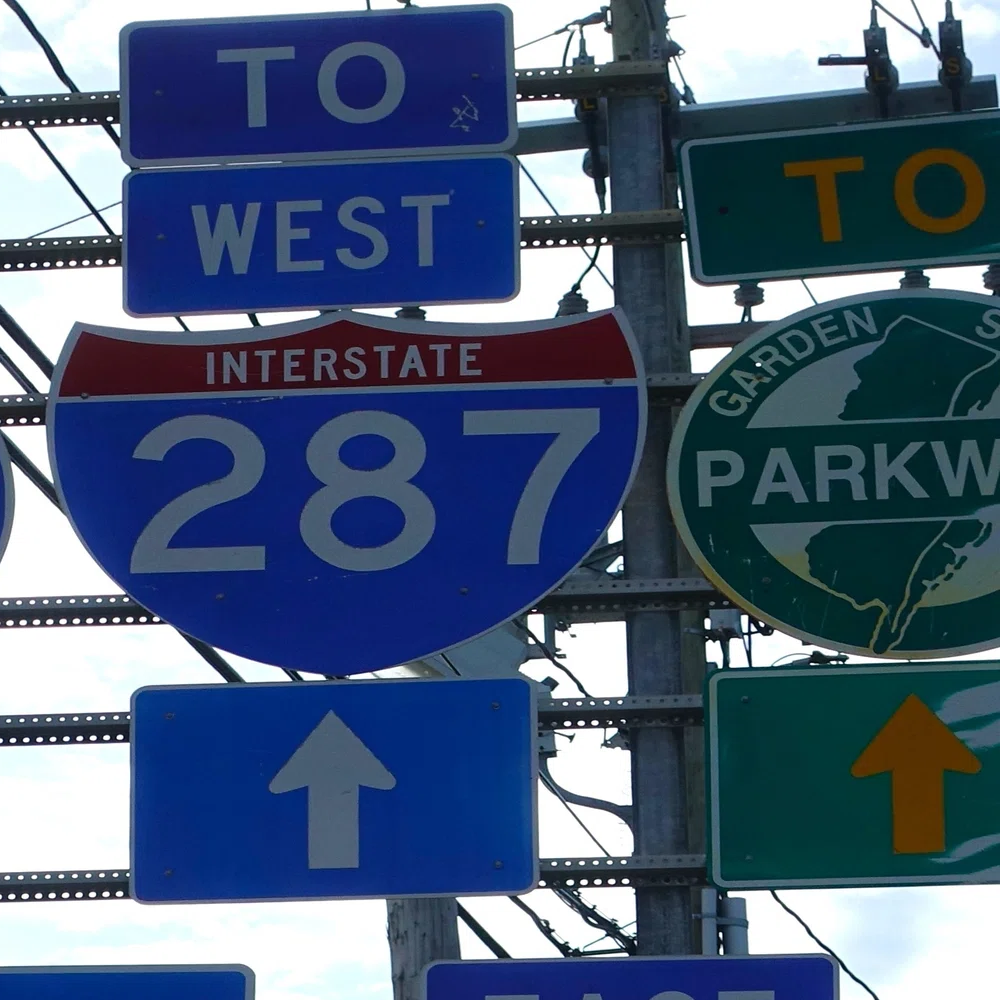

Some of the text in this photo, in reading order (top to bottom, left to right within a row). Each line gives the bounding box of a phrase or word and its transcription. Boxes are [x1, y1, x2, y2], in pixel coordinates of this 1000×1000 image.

[217, 41, 406, 128] TO
[191, 194, 450, 276] WEST
[784, 148, 985, 243] TO
[206, 343, 483, 385] INTERSTATE
[708, 306, 878, 417] GARDEN
[130, 407, 600, 574] 287
